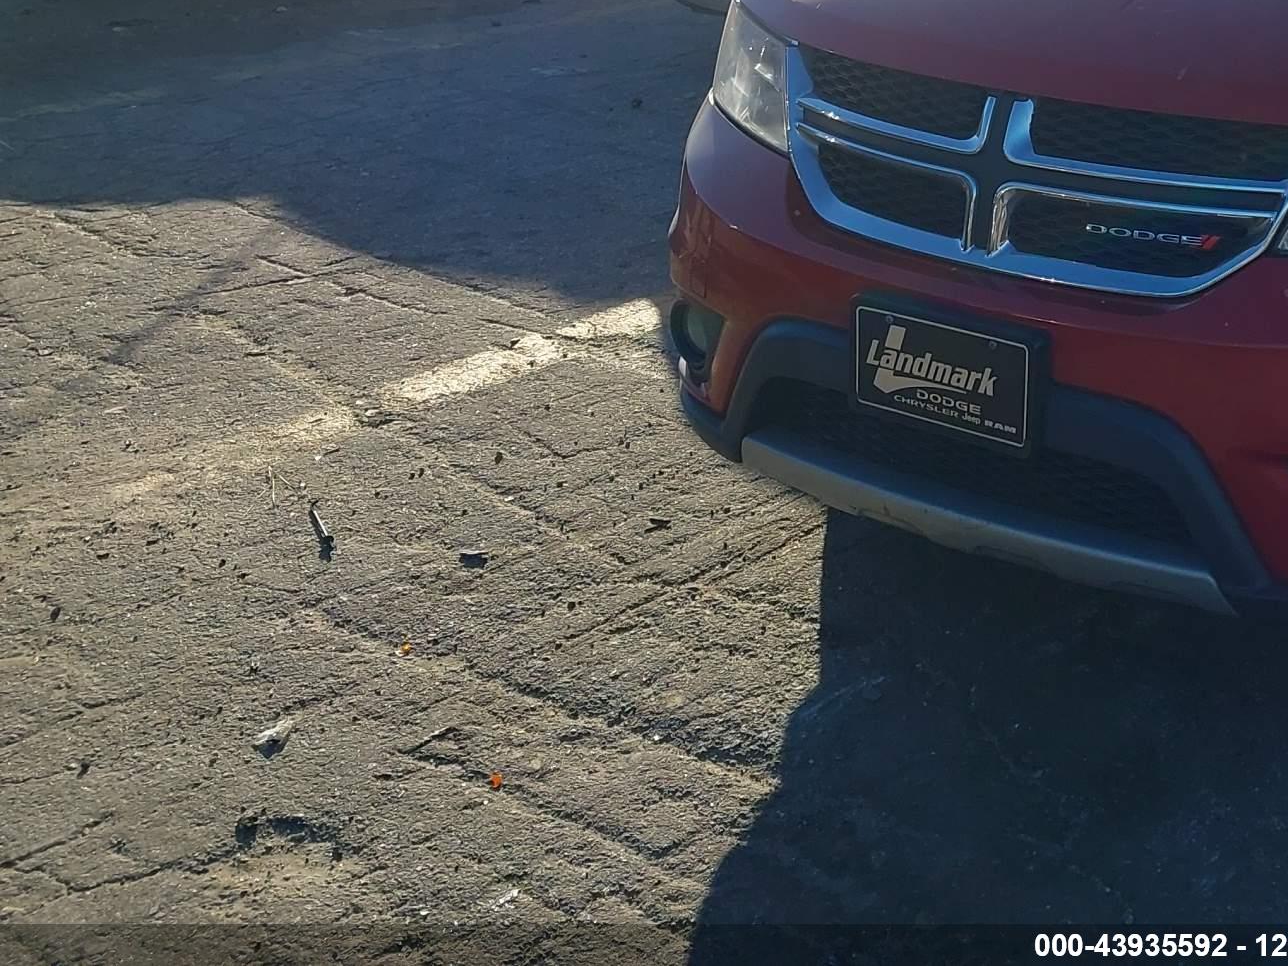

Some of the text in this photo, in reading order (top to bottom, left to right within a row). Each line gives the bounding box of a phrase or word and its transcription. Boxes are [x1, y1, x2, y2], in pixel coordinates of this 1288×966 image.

[1086, 223, 1203, 246] DODGE
[866, 339, 999, 397] Landmark
[893, 394, 1017, 434] CHRYSLER Jeep RAM
[916, 389, 982, 415] DODGE
